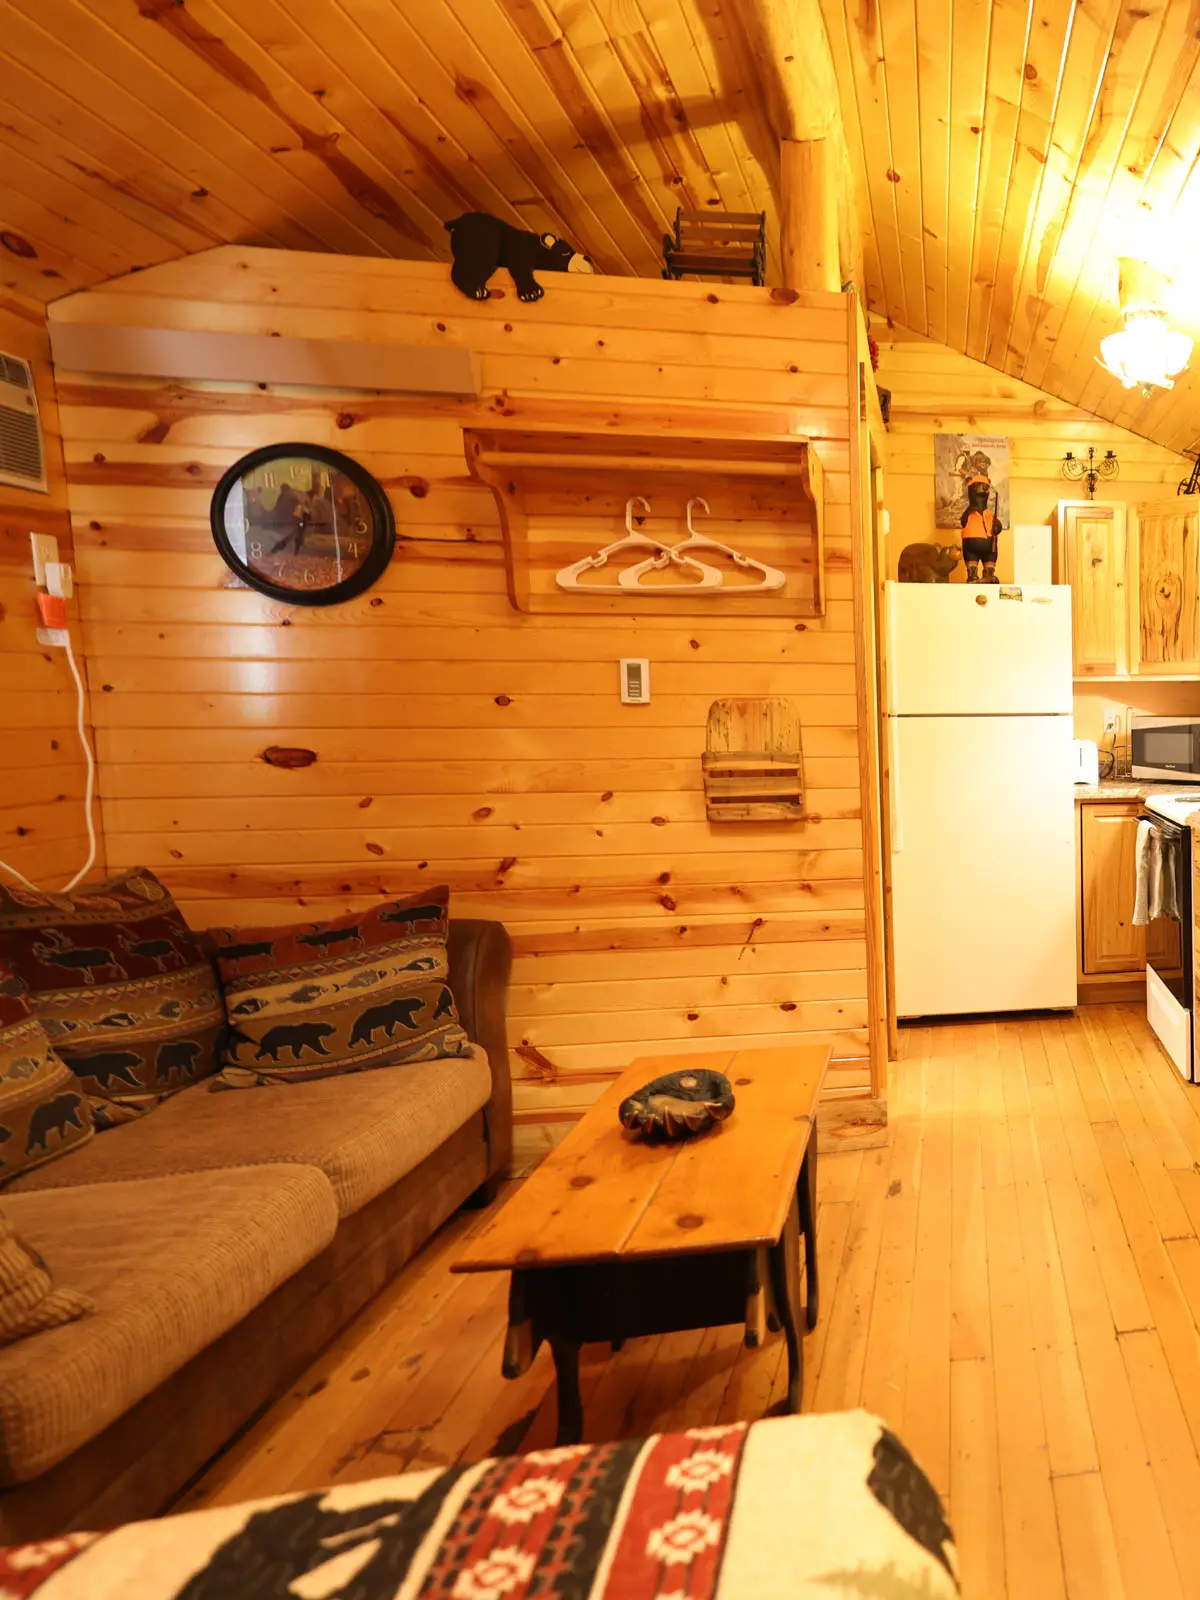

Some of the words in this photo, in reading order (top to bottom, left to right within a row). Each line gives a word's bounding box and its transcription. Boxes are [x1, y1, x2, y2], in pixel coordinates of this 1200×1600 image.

[289, 465, 304, 479] 12
[264, 472, 275, 488] 11
[355, 517, 368, 534] 3
[250, 541, 263, 559] 8
[347, 543, 358, 558] 4
[273, 562, 285, 577] 7
[303, 569, 315, 584] 6
